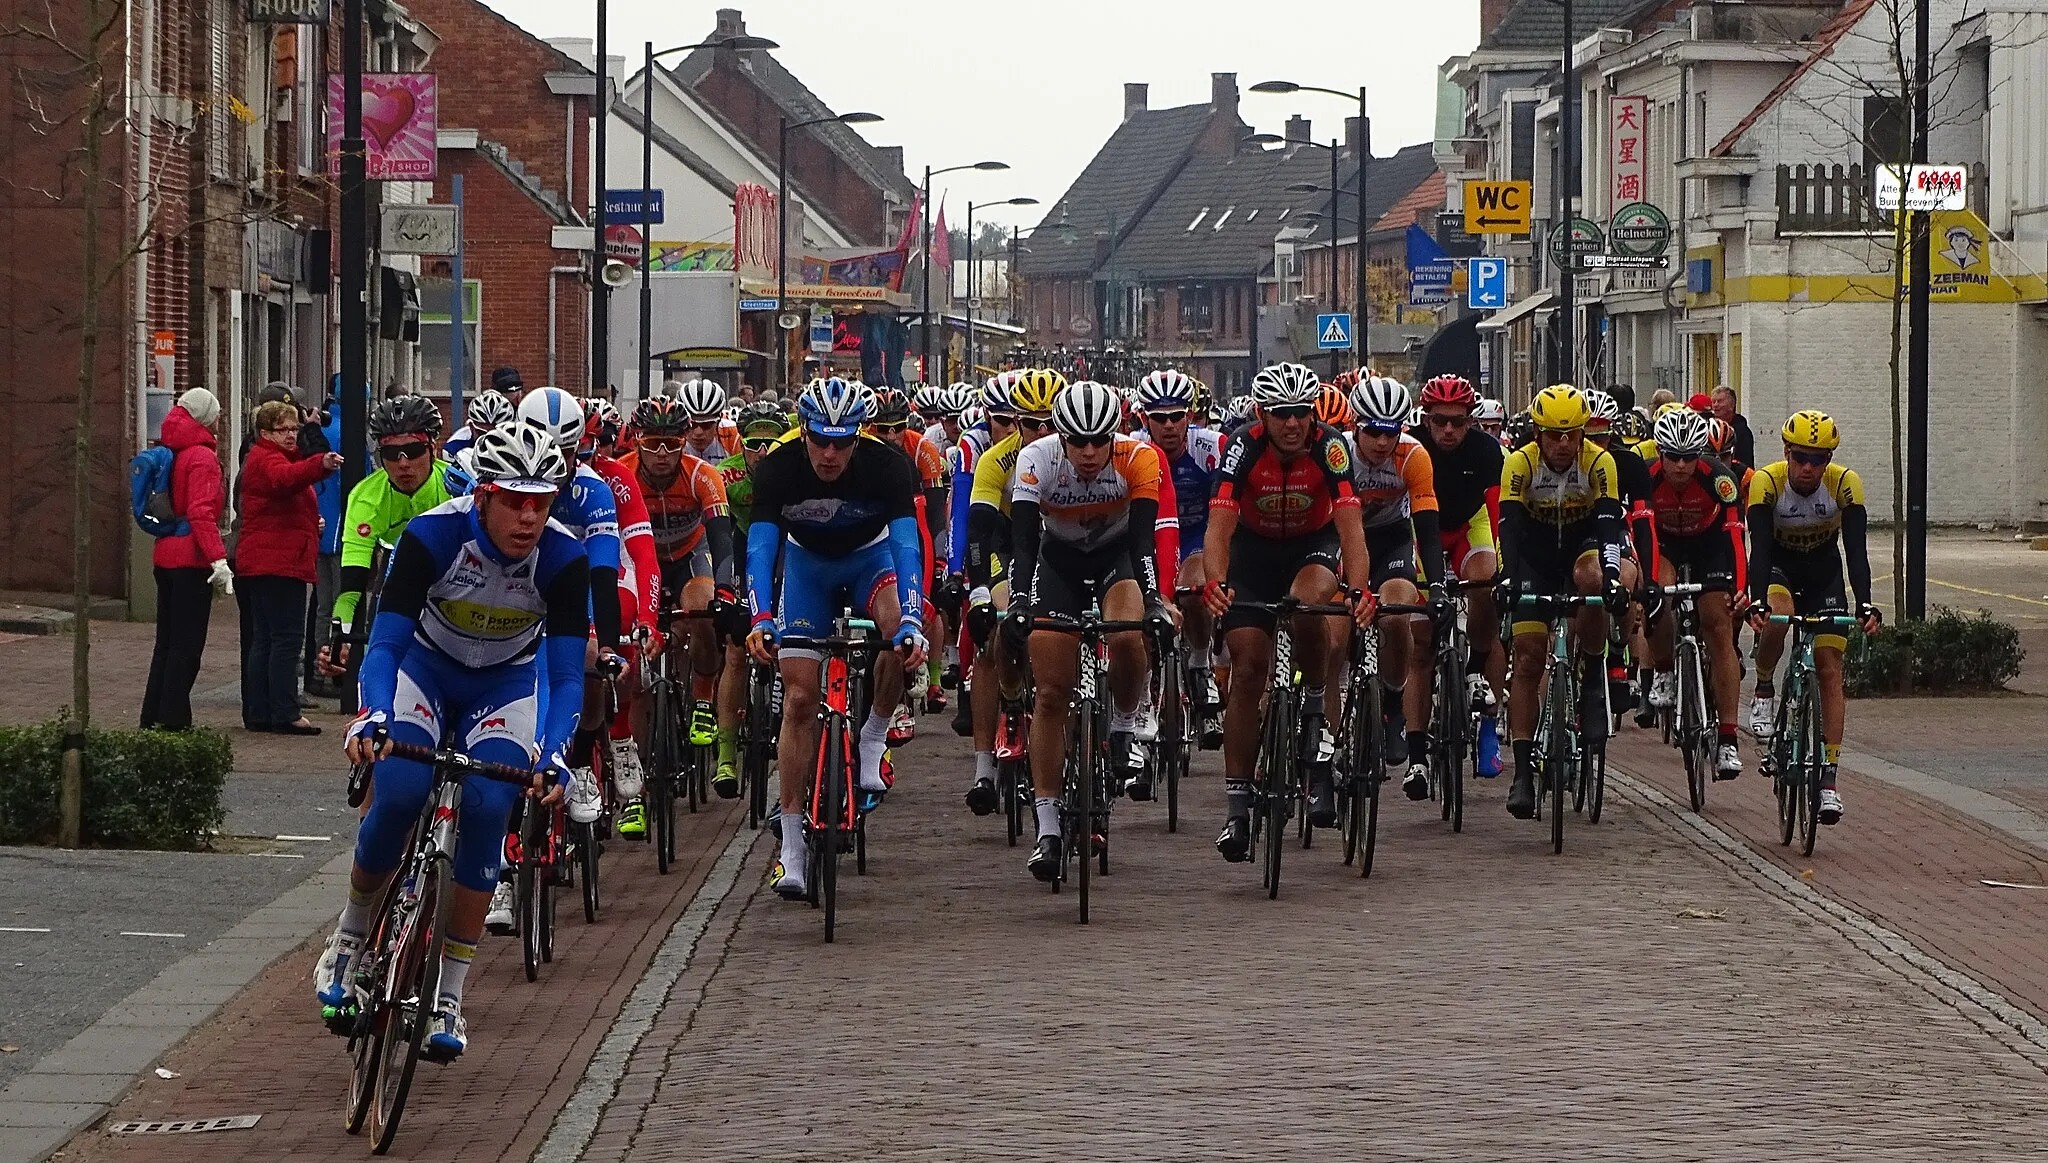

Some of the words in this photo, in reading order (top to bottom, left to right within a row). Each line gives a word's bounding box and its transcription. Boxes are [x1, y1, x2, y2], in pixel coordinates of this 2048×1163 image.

[397, 163, 428, 171] SHOP
[1476, 187, 1520, 210] WC
[605, 202, 660, 213] Restaurnt
[1617, 229, 1663, 239] Heineken
[606, 244, 639, 255] upiler
[1555, 242, 1599, 251] Hneken
[1479, 262, 1497, 288] P
[1934, 273, 1988, 285] ZEEMAN
[604, 475, 631, 504] ofidis
[1050, 490, 1123, 505] Rabobank
